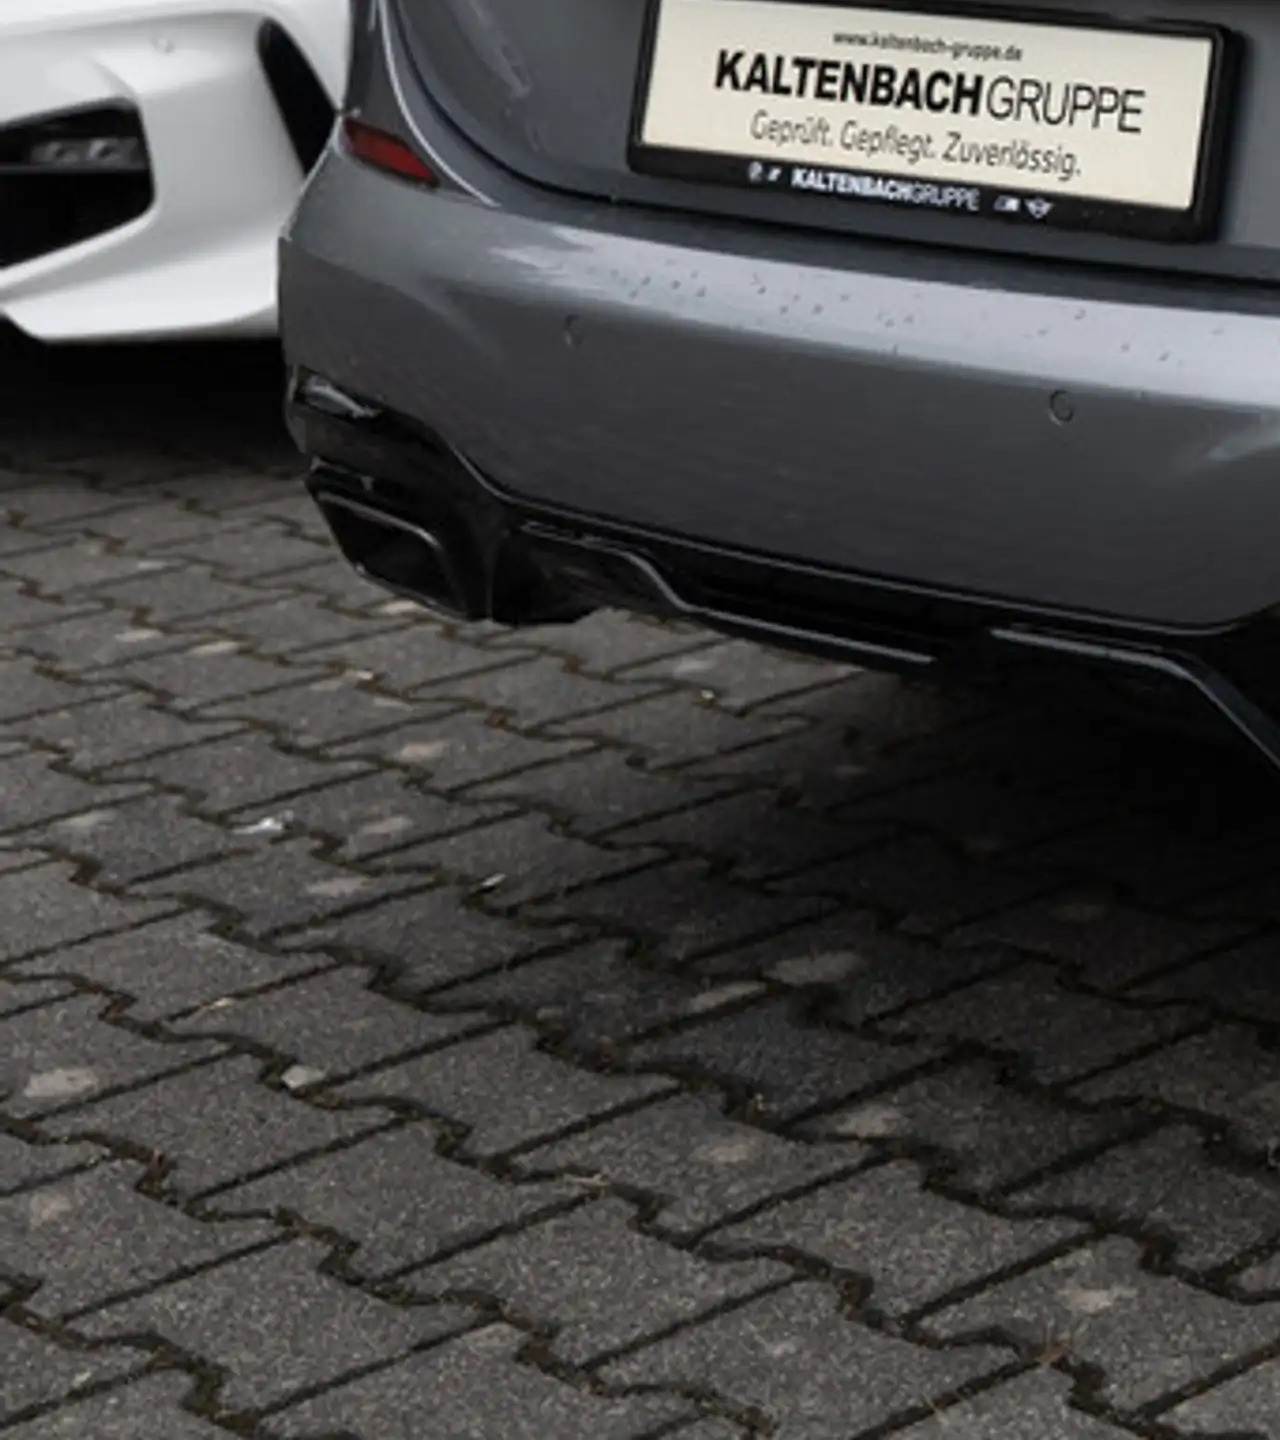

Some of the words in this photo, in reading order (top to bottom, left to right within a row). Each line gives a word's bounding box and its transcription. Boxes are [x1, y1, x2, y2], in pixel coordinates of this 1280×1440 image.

[832, 31, 1022, 61] www.kaltenbach-gruppe.de
[714, 48, 1145, 133] KALTENBACHGRUPPE
[751, 110, 834, 147] Geprüft.
[841, 120, 936, 165] Gepflegt.
[942, 130, 1081, 182] Zuverlässig.
[791, 167, 981, 211] KALTENBACHGRUPPE
